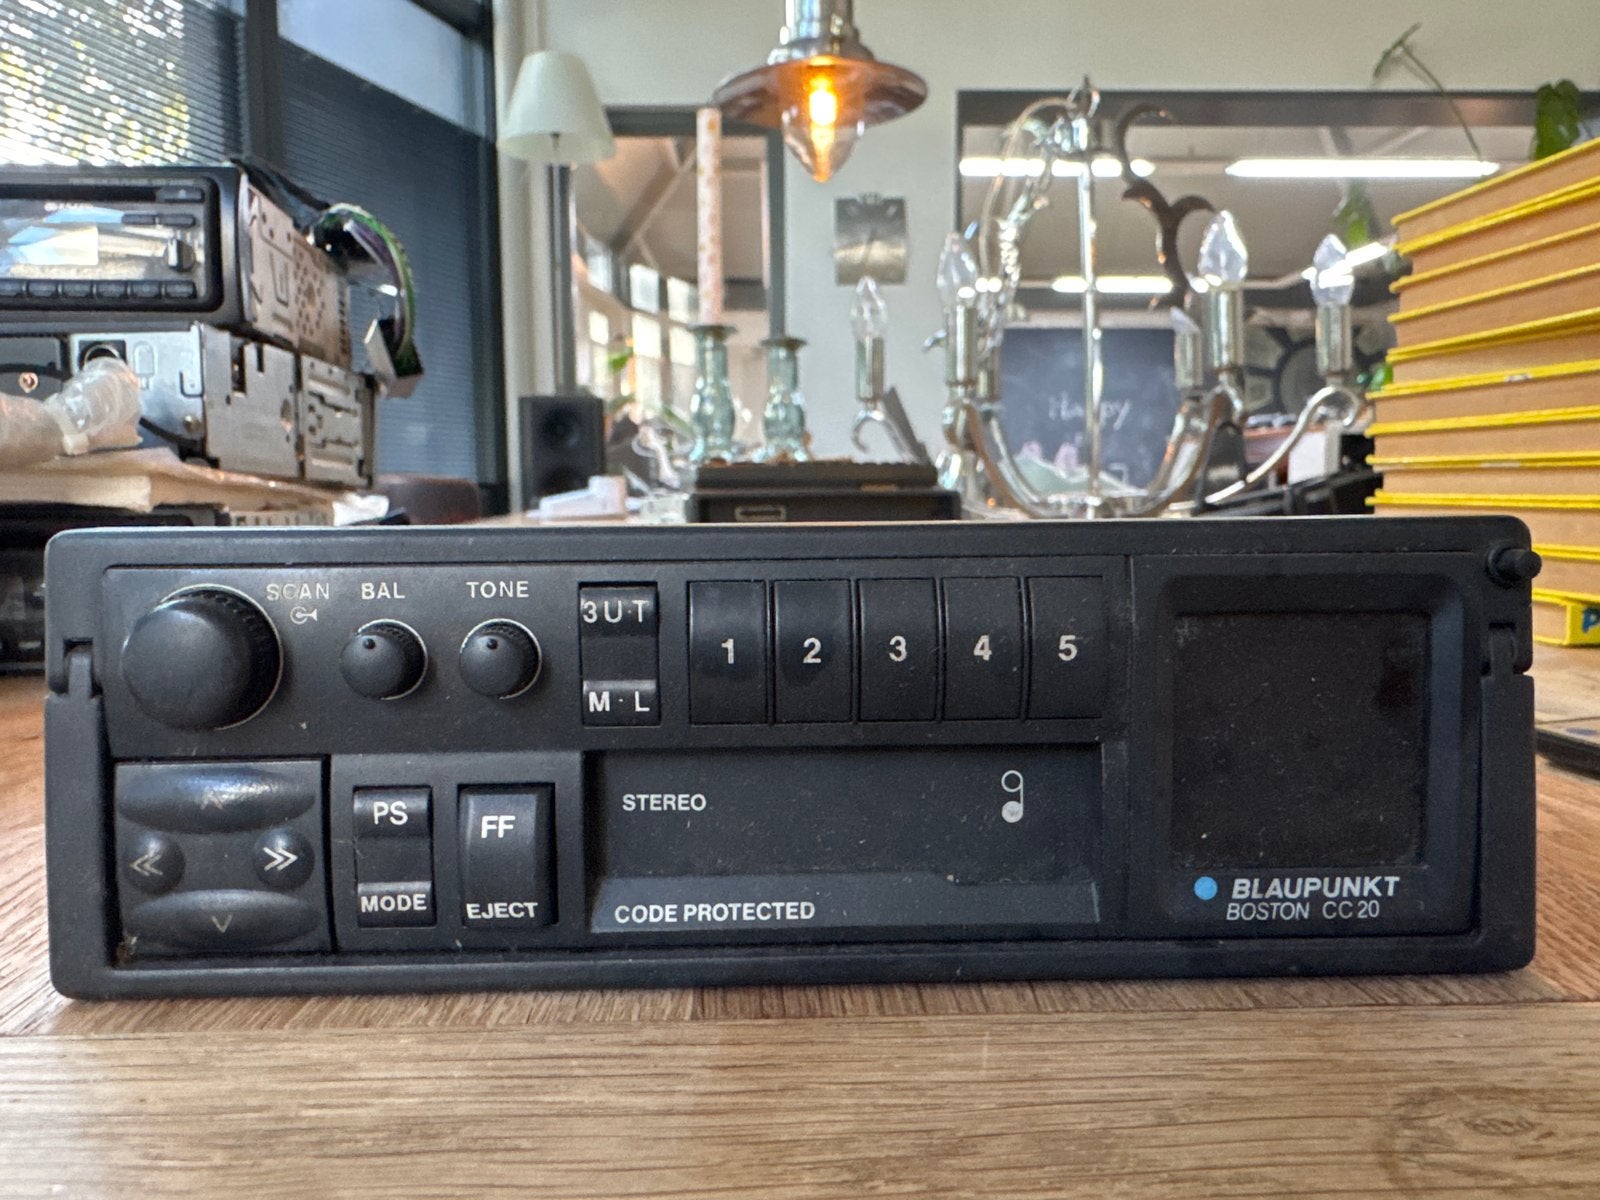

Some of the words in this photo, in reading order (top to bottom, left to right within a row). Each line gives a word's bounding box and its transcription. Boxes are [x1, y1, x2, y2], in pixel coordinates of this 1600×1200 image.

[266, 582, 330, 601] SCAN
[360, 581, 406, 600] BAL
[466, 580, 530, 599] TONE
[720, 637, 735, 664] 1
[802, 636, 822, 664] 2
[888, 634, 908, 662] 3
[972, 634, 993, 661] 4
[1057, 634, 1079, 662] 5
[621, 793, 707, 812] STEREO
[372, 801, 409, 826] PS
[480, 815, 517, 839] FF
[1231, 875, 1400, 900] BLAUPUNKT
[360, 893, 428, 913] MODE
[466, 902, 539, 920] EJECT
[614, 904, 678, 924] CODE
[683, 901, 816, 922] PROTECTED
[1226, 902, 1310, 921] BOSTON
